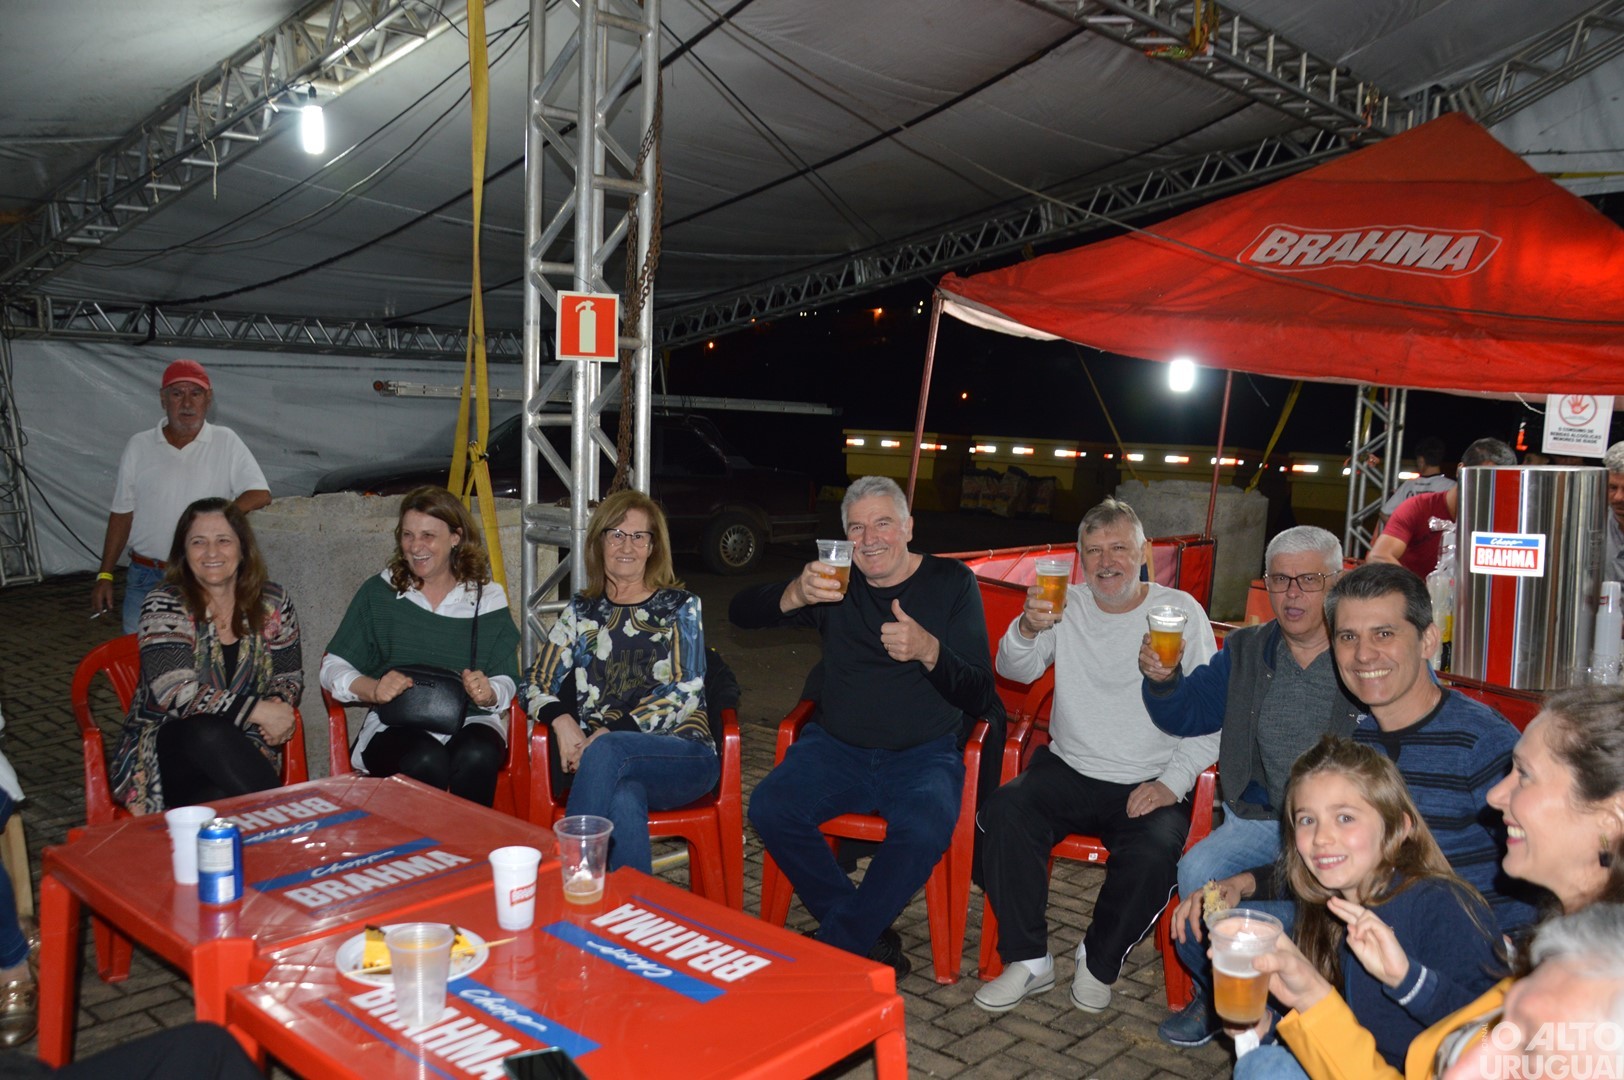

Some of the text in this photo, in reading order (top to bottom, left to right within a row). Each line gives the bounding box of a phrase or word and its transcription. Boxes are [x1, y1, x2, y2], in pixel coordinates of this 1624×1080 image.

[1249, 228, 1481, 271] BRAHMA
[1476, 547, 1535, 569] BRAHMA
[228, 796, 341, 832] BRAH
[283, 850, 472, 908] BRAHMA
[310, 850, 395, 877] Chopp
[586, 941, 673, 978] Chopp
[590, 903, 772, 983] BRAHMA
[459, 989, 548, 1032] Chopp
